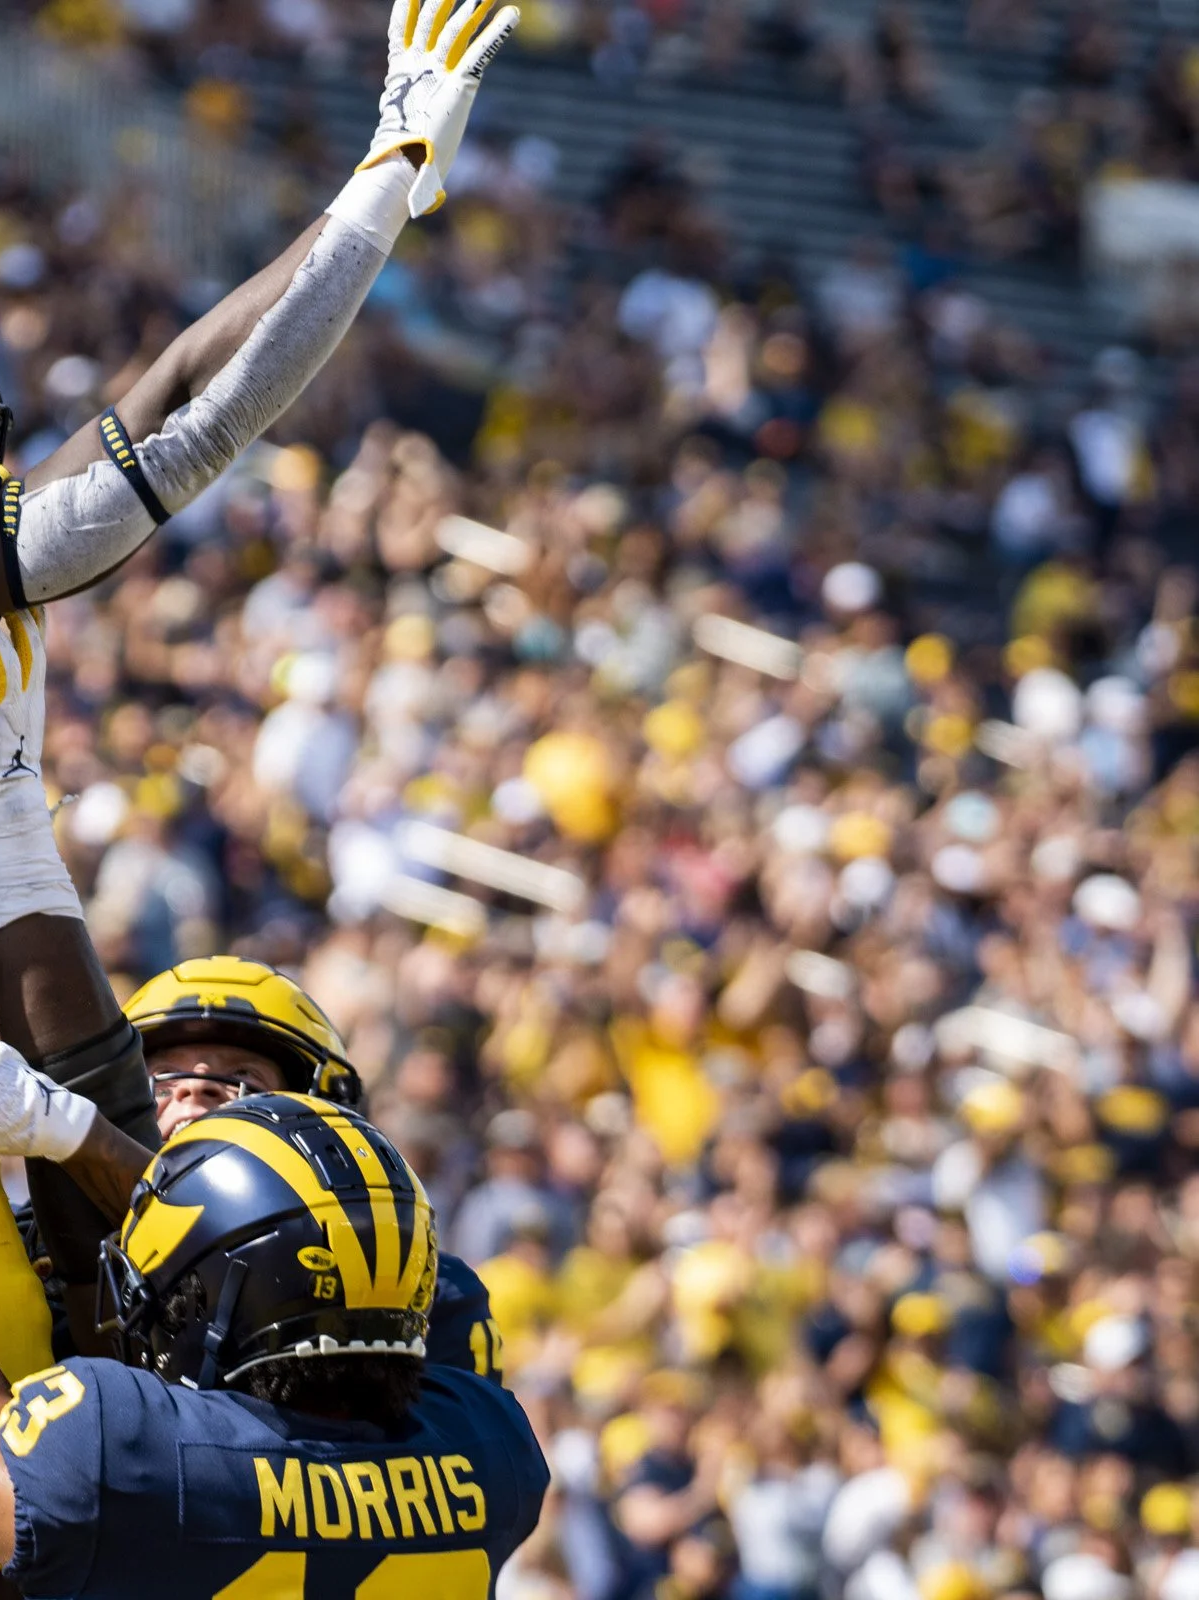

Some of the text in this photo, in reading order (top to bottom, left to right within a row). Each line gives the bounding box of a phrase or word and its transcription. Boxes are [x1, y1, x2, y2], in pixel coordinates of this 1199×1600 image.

[468, 24, 512, 80] MICHIGAN
[313, 1274, 337, 1299] 13
[253, 1454, 486, 1540] MORRIS
